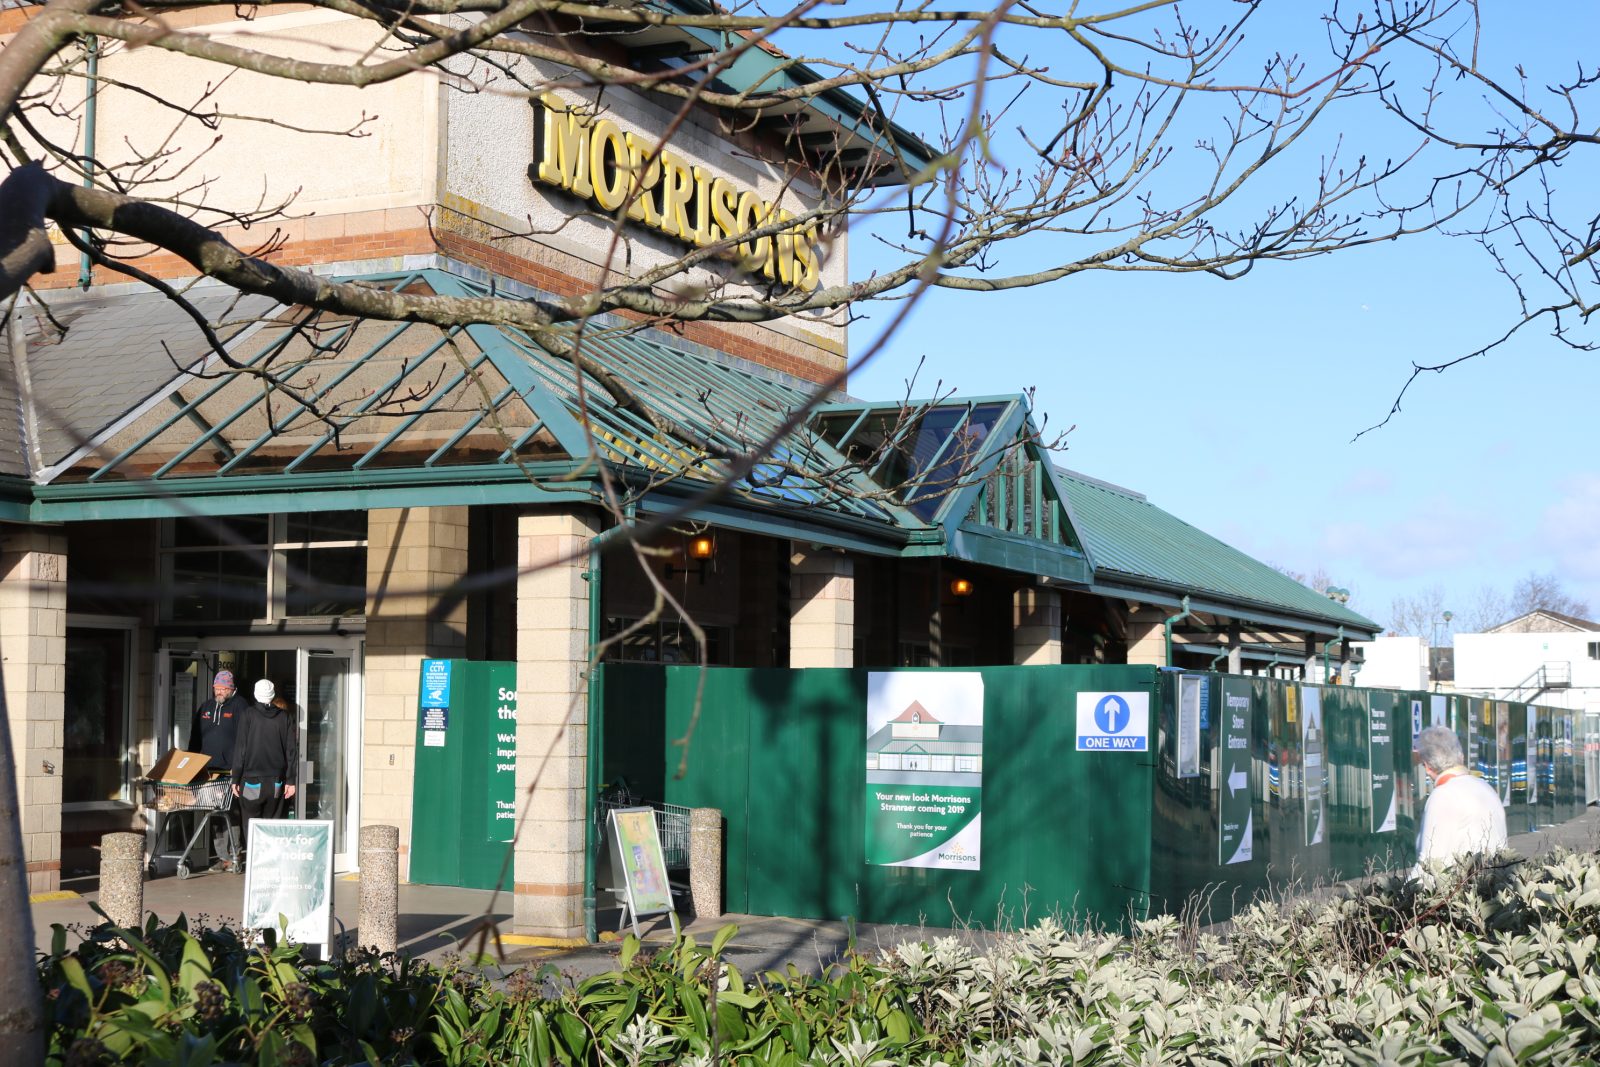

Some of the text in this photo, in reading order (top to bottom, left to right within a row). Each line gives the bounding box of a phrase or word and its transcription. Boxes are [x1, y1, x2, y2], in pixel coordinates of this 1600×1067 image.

[537, 92, 820, 293] MORRISONS
[1086, 737, 1138, 748] ONE WAY
[875, 792, 894, 801] Your
[912, 793, 930, 802] look
[931, 794, 971, 804] Morrisons
[880, 802, 965, 815] Stranraer coming 2019
[896, 822, 913, 830] Thank
[295, 834, 314, 845] for
[938, 853, 977, 862] Morrisons
